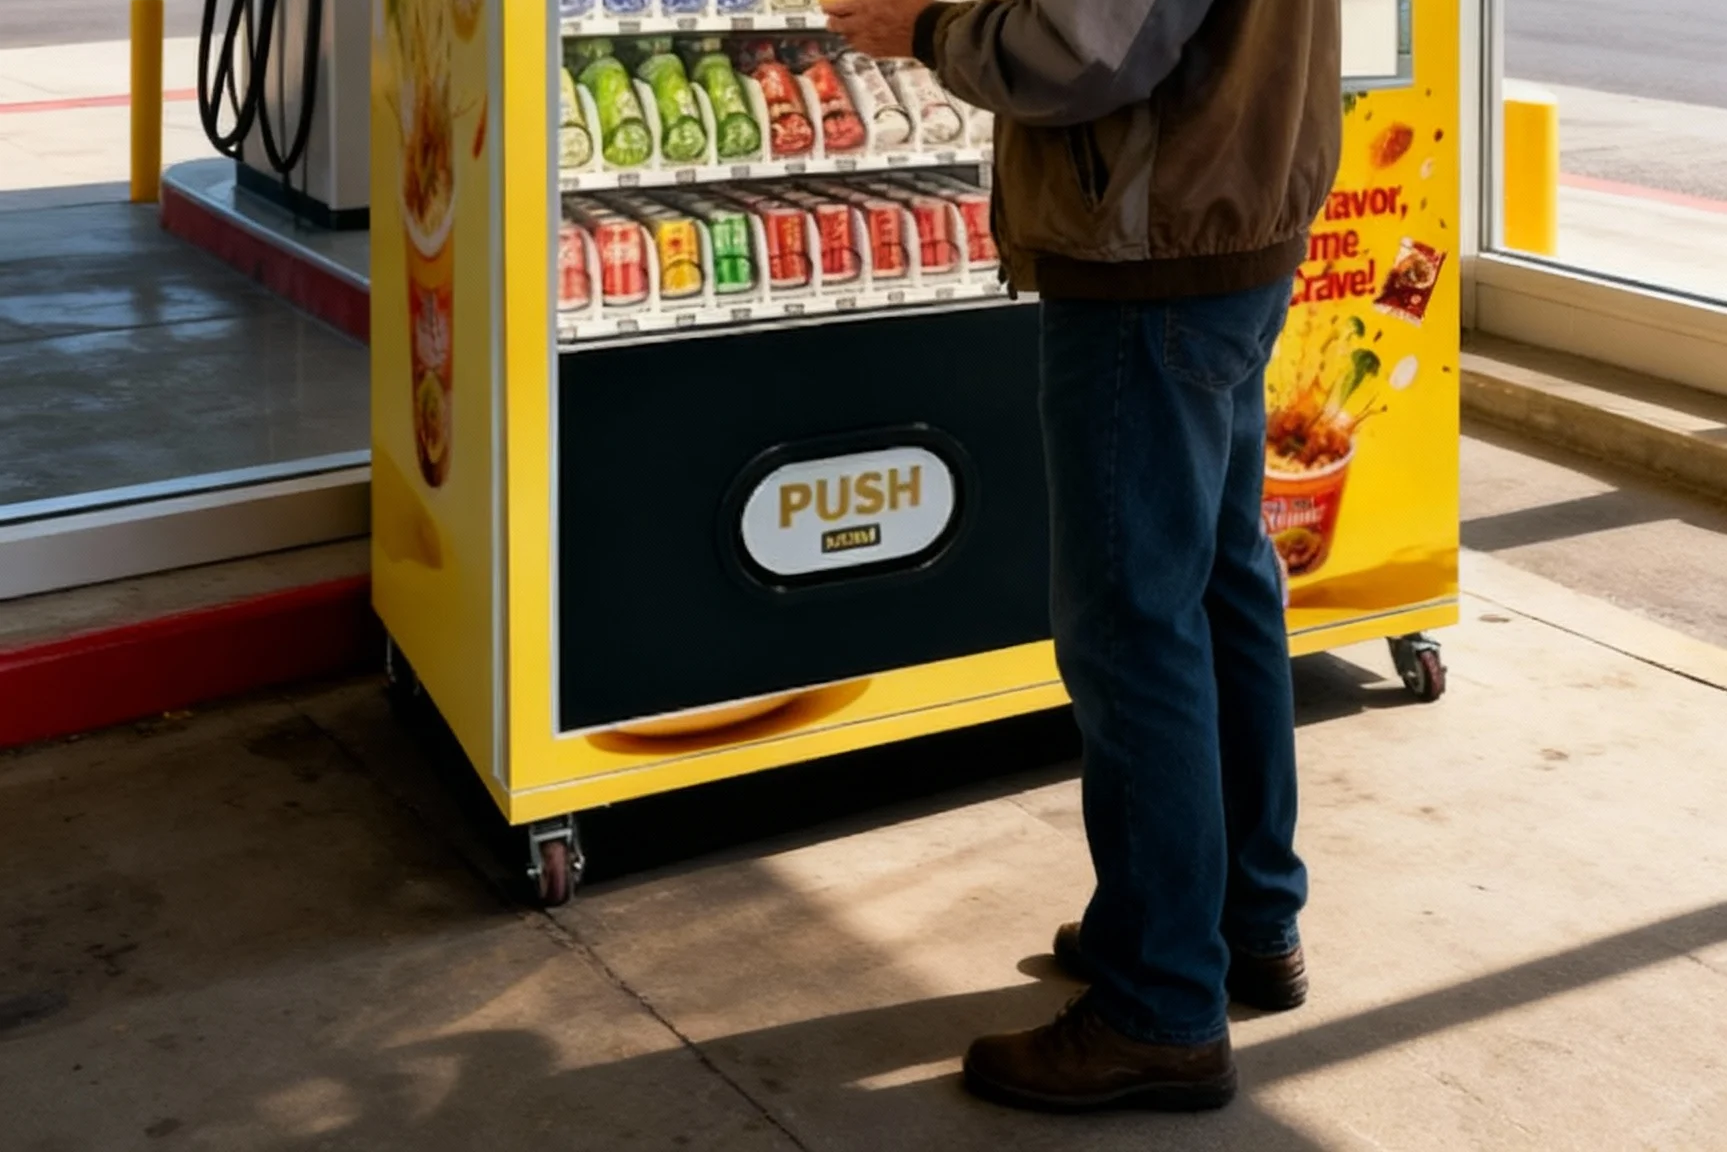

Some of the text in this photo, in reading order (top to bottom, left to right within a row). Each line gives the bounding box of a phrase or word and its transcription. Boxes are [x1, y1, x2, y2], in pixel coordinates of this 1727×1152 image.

[1325, 185, 1408, 221] lavor,
[1309, 230, 1359, 260] me
[778, 465, 922, 529] PUSH
